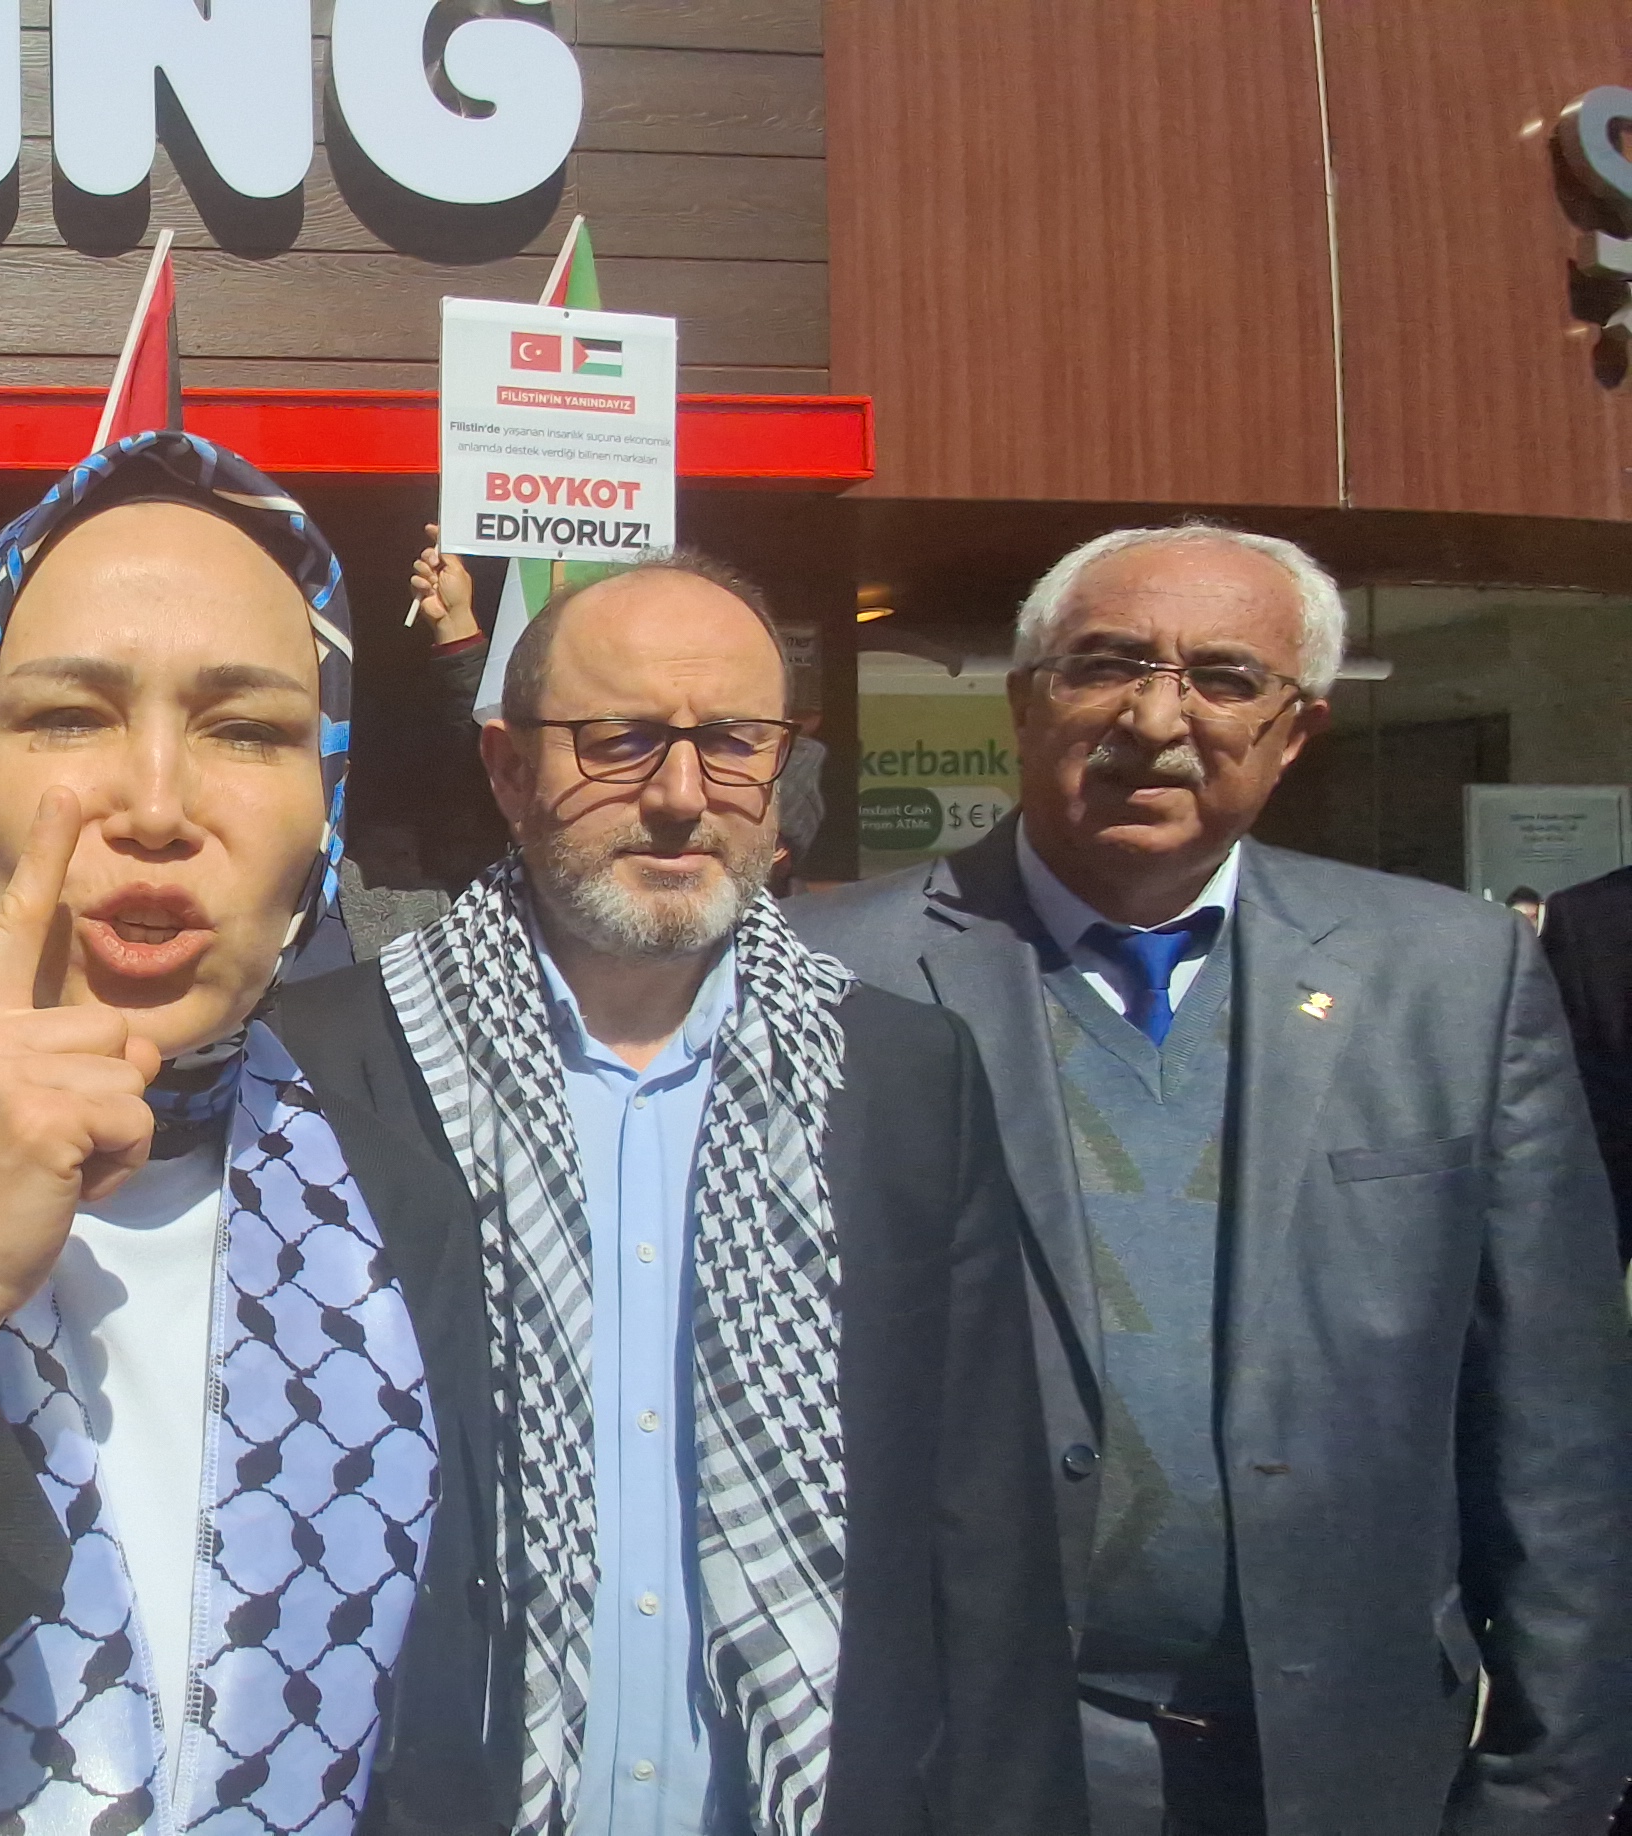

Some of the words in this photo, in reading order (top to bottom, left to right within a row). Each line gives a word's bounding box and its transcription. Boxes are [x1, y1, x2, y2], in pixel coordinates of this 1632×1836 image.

[564, 395, 632, 411] YANINDAYIZ
[503, 427, 545, 437] yaşanan
[586, 433, 622, 443] suçuna
[624, 434, 672, 447] ekonomik
[458, 442, 502, 454] anlamda
[505, 445, 540, 456] destek
[542, 447, 576, 460] verdiği
[578, 449, 611, 460] bilinen
[485, 471, 641, 511] BOYKOT
[475, 508, 651, 549] EDİYORUZ!
